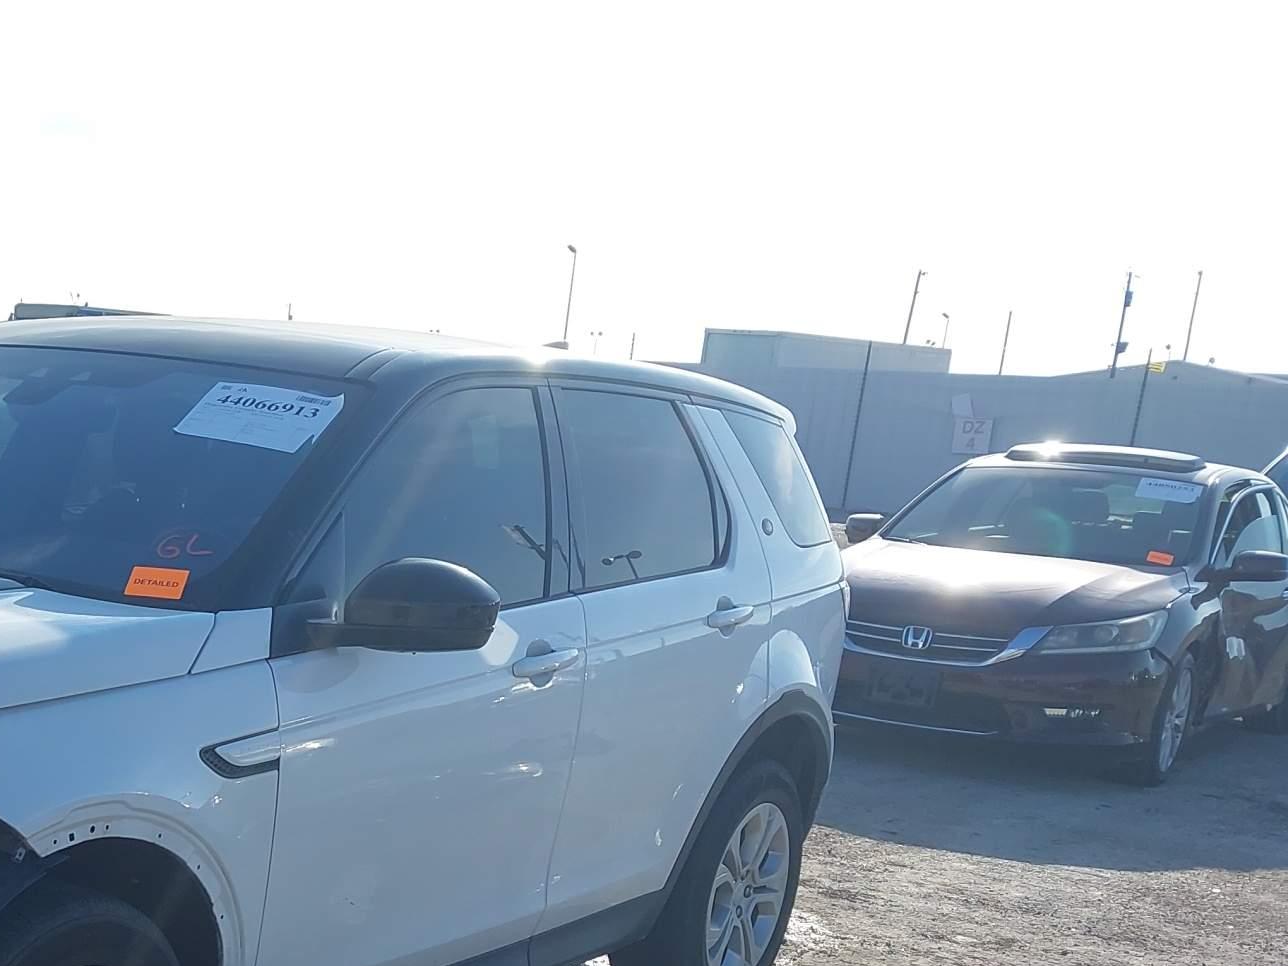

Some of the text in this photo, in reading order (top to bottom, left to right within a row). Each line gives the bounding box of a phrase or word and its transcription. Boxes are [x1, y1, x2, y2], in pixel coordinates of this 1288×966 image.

[217, 394, 319, 419] 44066913
[962, 420, 985, 434] DZ
[133, 578, 179, 588] DETAILED
